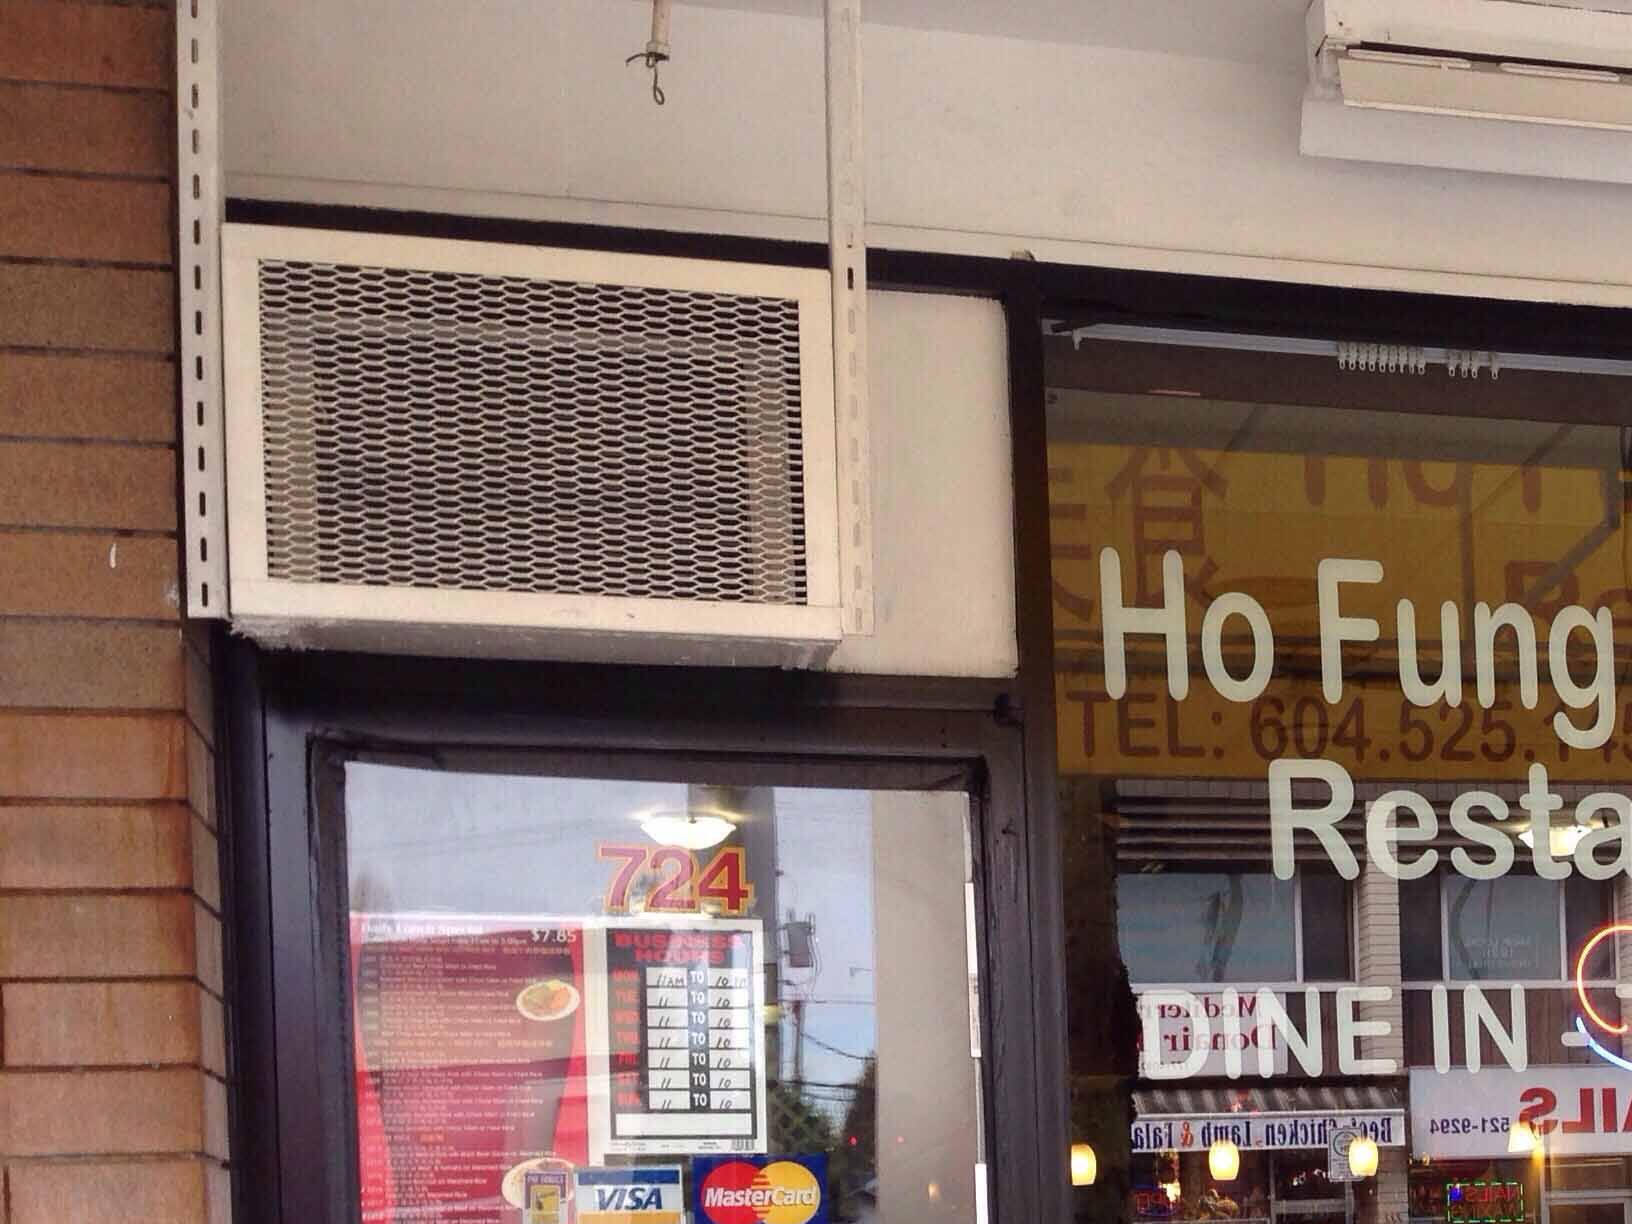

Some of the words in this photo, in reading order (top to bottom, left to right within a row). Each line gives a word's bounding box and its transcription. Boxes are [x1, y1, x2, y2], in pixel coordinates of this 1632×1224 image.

[1100, 546, 1275, 702] Ho
[1317, 558, 1617, 750] Fung
[1064, 690, 1226, 761] TEL:
[599, 842, 756, 914] 724
[690, 970, 705, 984] TO
[690, 991, 705, 1005] TO
[691, 1011, 706, 1024] TO
[691, 1032, 706, 1045] TO
[1136, 984, 1398, 1081] DINE
[1431, 984, 1529, 1074] IN
[692, 1052, 707, 1065] TO
[692, 1073, 707, 1086] TO
[692, 1093, 707, 1107] TO
[593, 1186, 664, 1211] VISA
[703, 1186, 817, 1209] MasterCard
